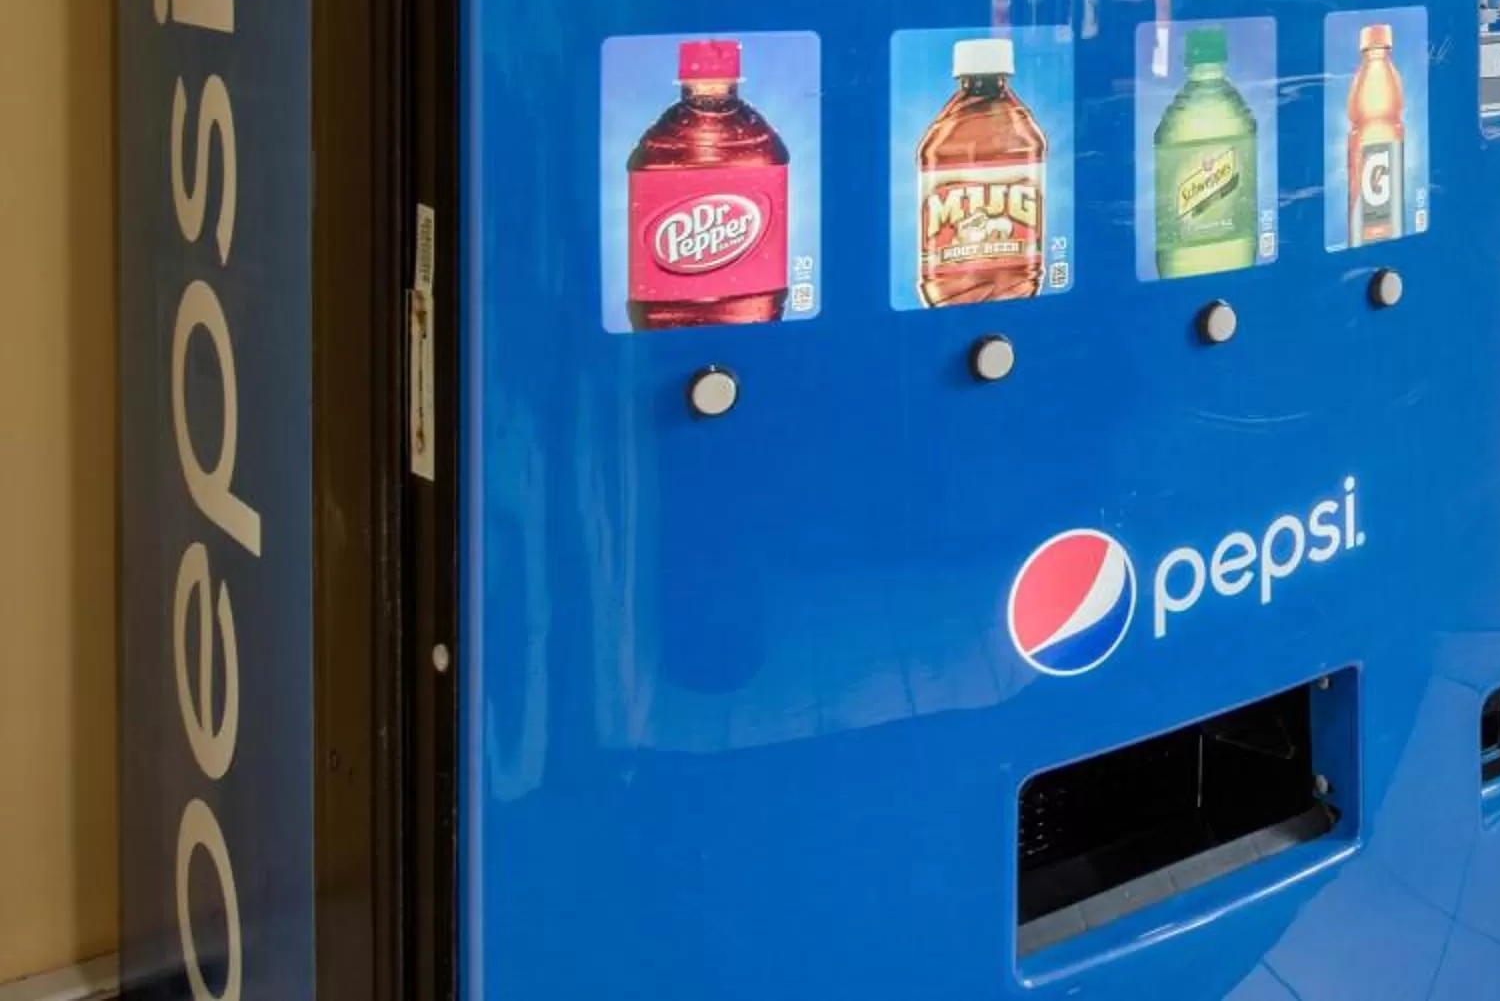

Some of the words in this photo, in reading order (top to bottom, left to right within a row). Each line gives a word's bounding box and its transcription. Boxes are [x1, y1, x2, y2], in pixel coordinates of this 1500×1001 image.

[1362, 151, 1390, 207] G
[664, 212, 753, 263] Pepper
[692, 203, 731, 235] Dr
[928, 184, 1036, 238] MUG
[1154, 475, 1366, 639] pepsi
